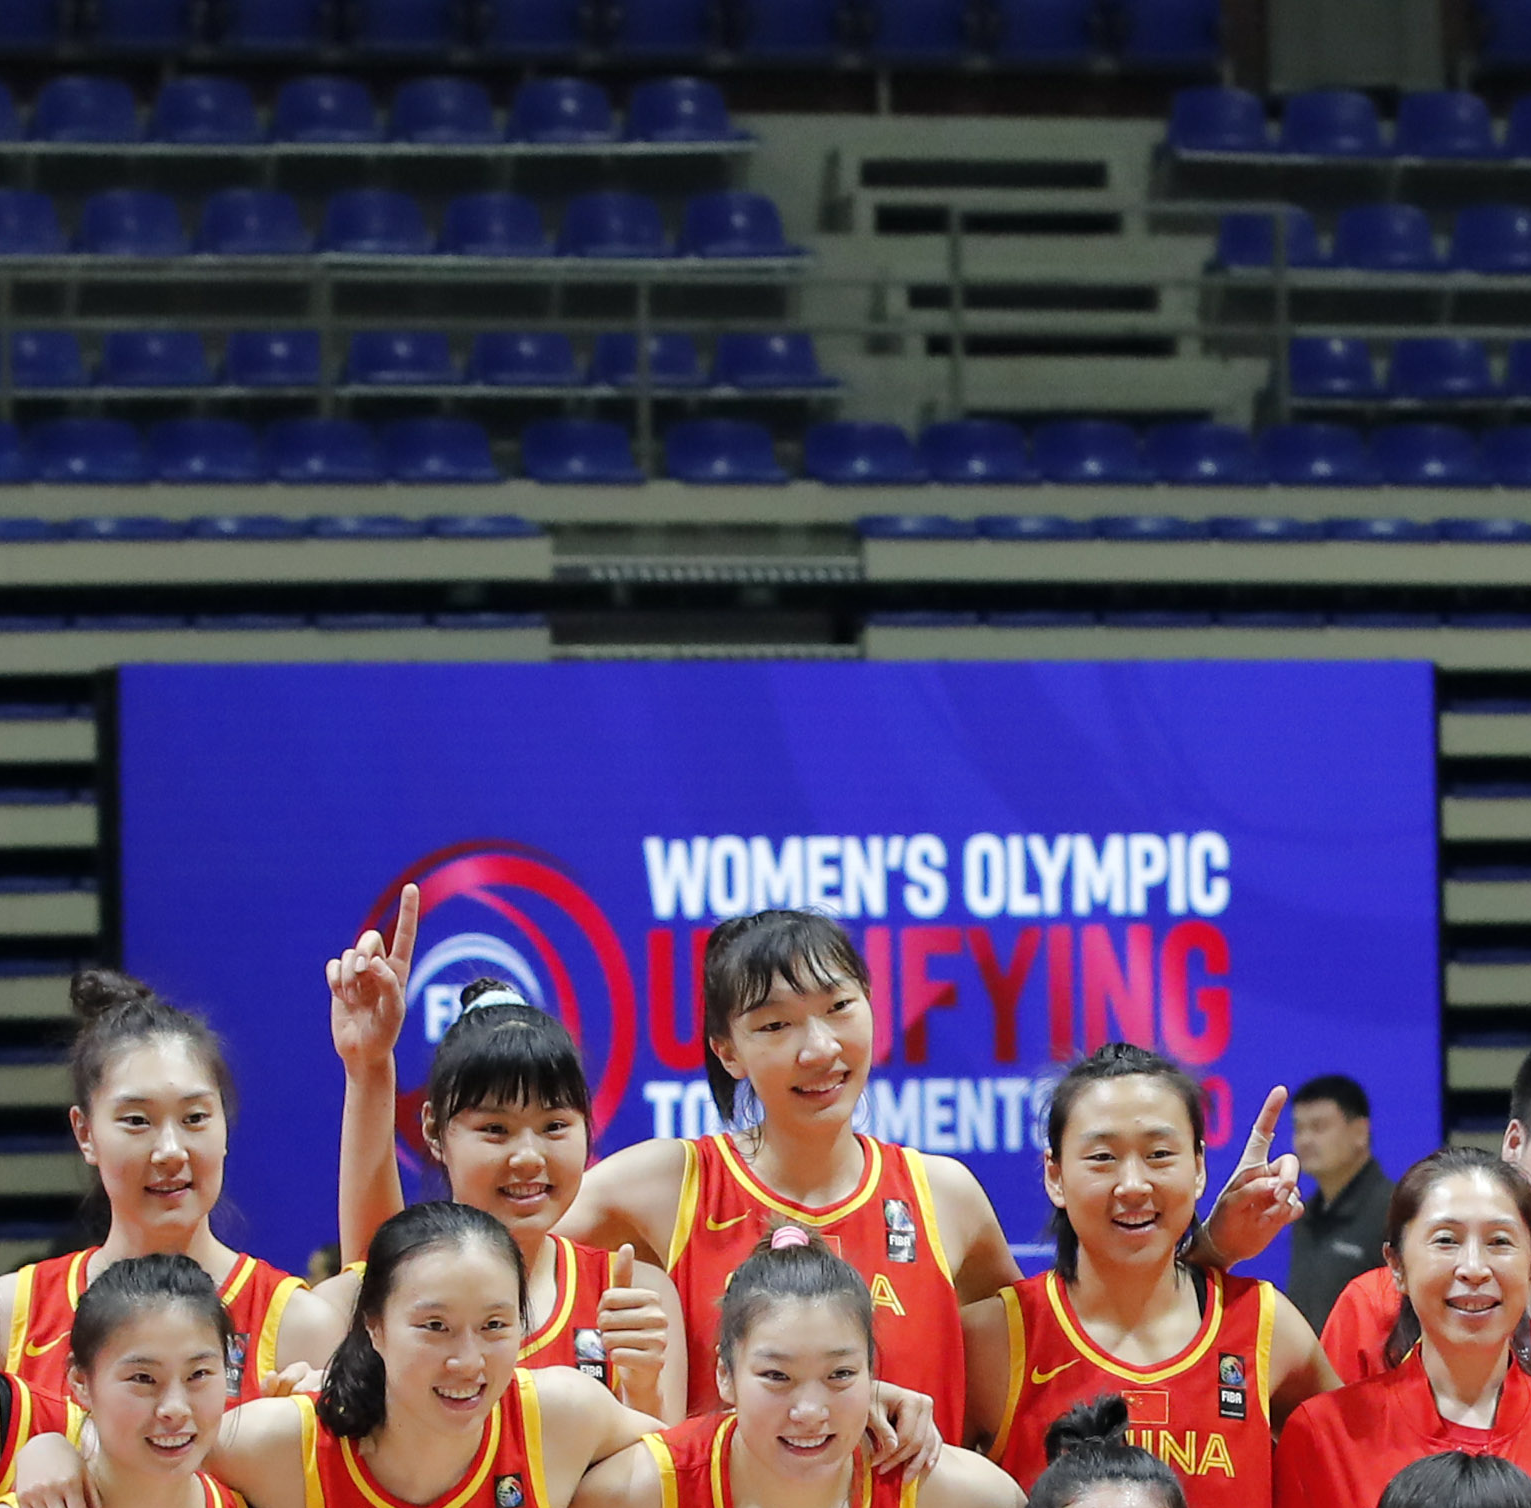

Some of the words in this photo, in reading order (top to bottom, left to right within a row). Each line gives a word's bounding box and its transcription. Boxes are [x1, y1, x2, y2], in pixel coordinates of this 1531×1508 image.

[643, 835, 949, 919] WOMEN'S
[964, 832, 1230, 916] OLYMPIC
[889, 1235, 911, 1248] FIBA
[1221, 1390, 1243, 1405] FIBA
[1125, 1429, 1236, 1478] INA
